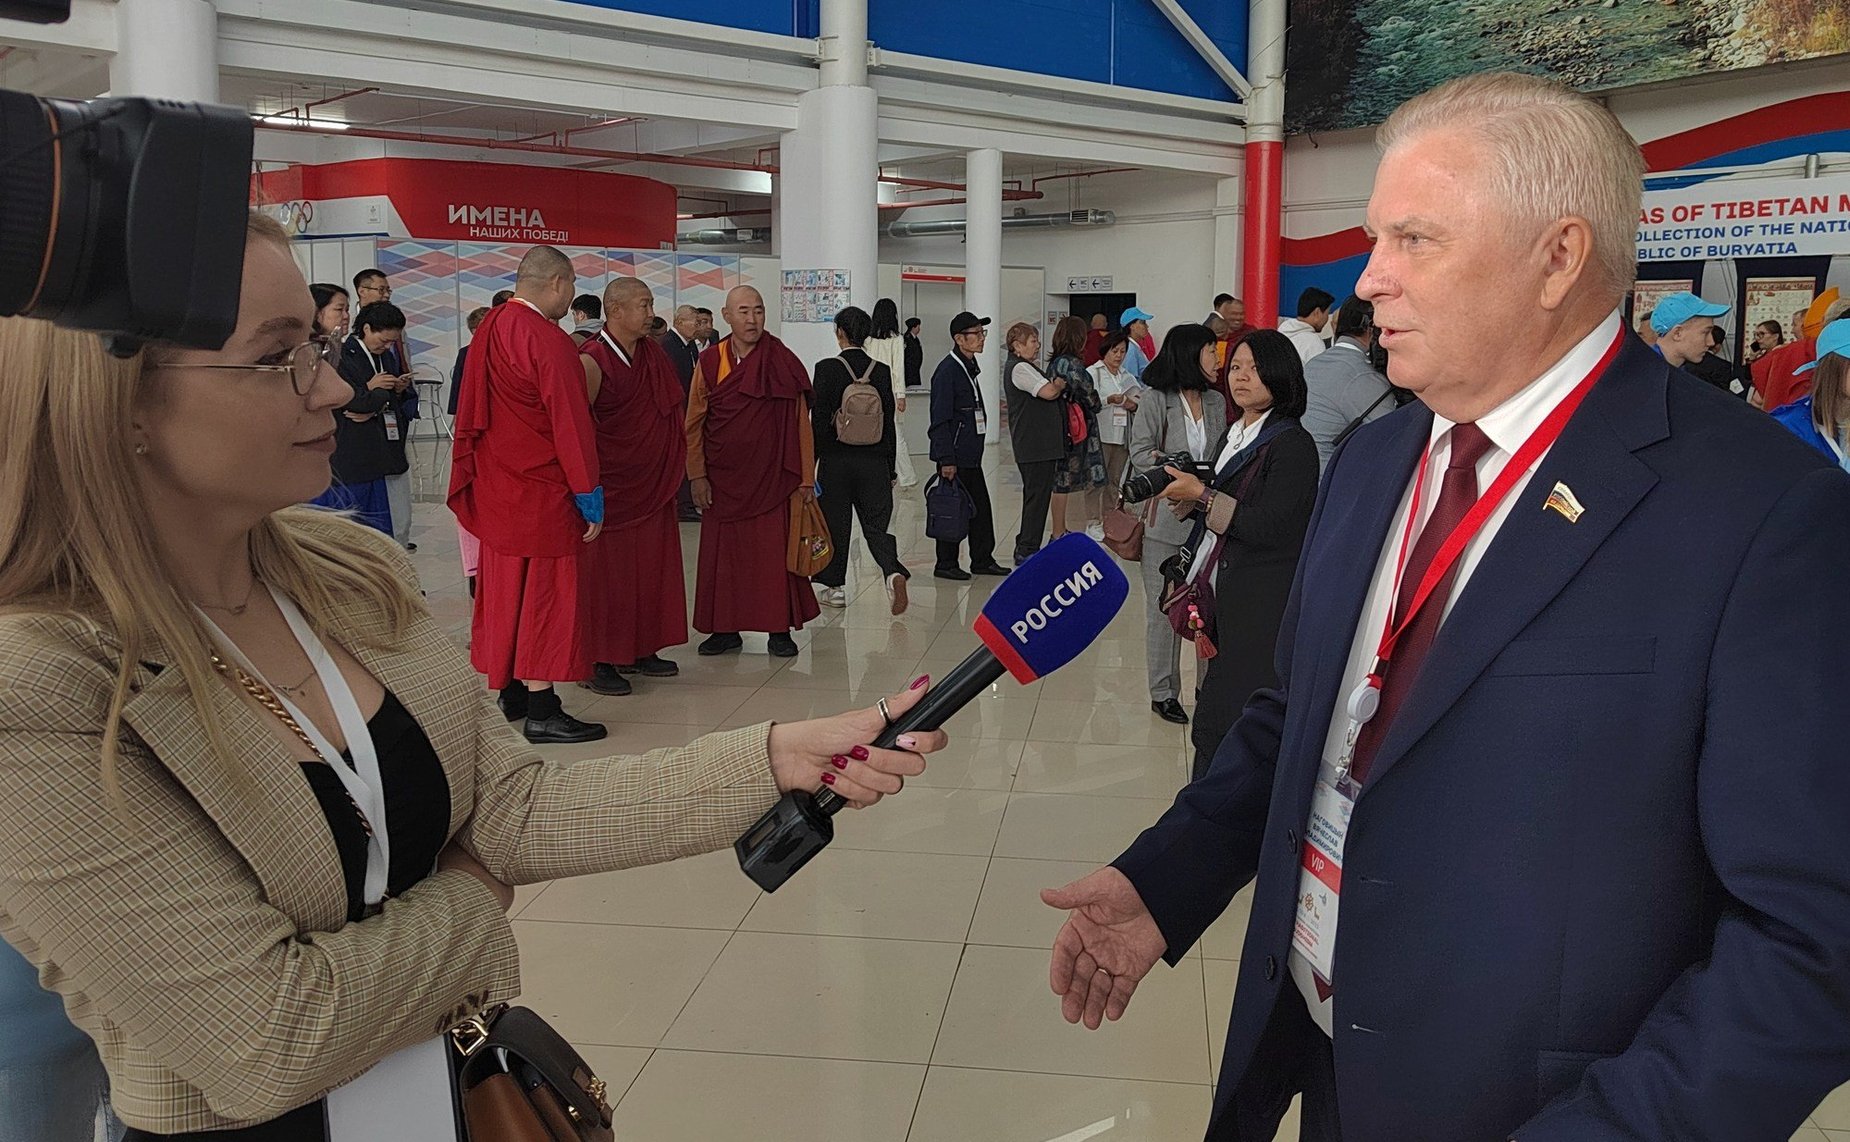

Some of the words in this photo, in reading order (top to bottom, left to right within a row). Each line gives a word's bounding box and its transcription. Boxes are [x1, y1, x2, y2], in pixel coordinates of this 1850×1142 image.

[448, 204, 546, 228] ИМЕНА
[1638, 207, 1665, 225] AS
[1671, 204, 1705, 223] OF
[1711, 195, 1829, 220] TIBETAN
[470, 226, 520, 239] НАШИХ
[523, 229, 569, 242] ПОБЕД!
[1635, 226, 1726, 243] OLLECTION
[1731, 224, 1755, 238] OF
[1756, 222, 1795, 236] THE
[1800, 219, 1850, 234] NATI
[1637, 246, 1675, 260] BLIC
[1680, 245, 1703, 259] OF
[1706, 242, 1798, 257] BURYATIA
[1010, 561, 1104, 645] РОССИЯ
[1311, 853, 1325, 872] VIP
